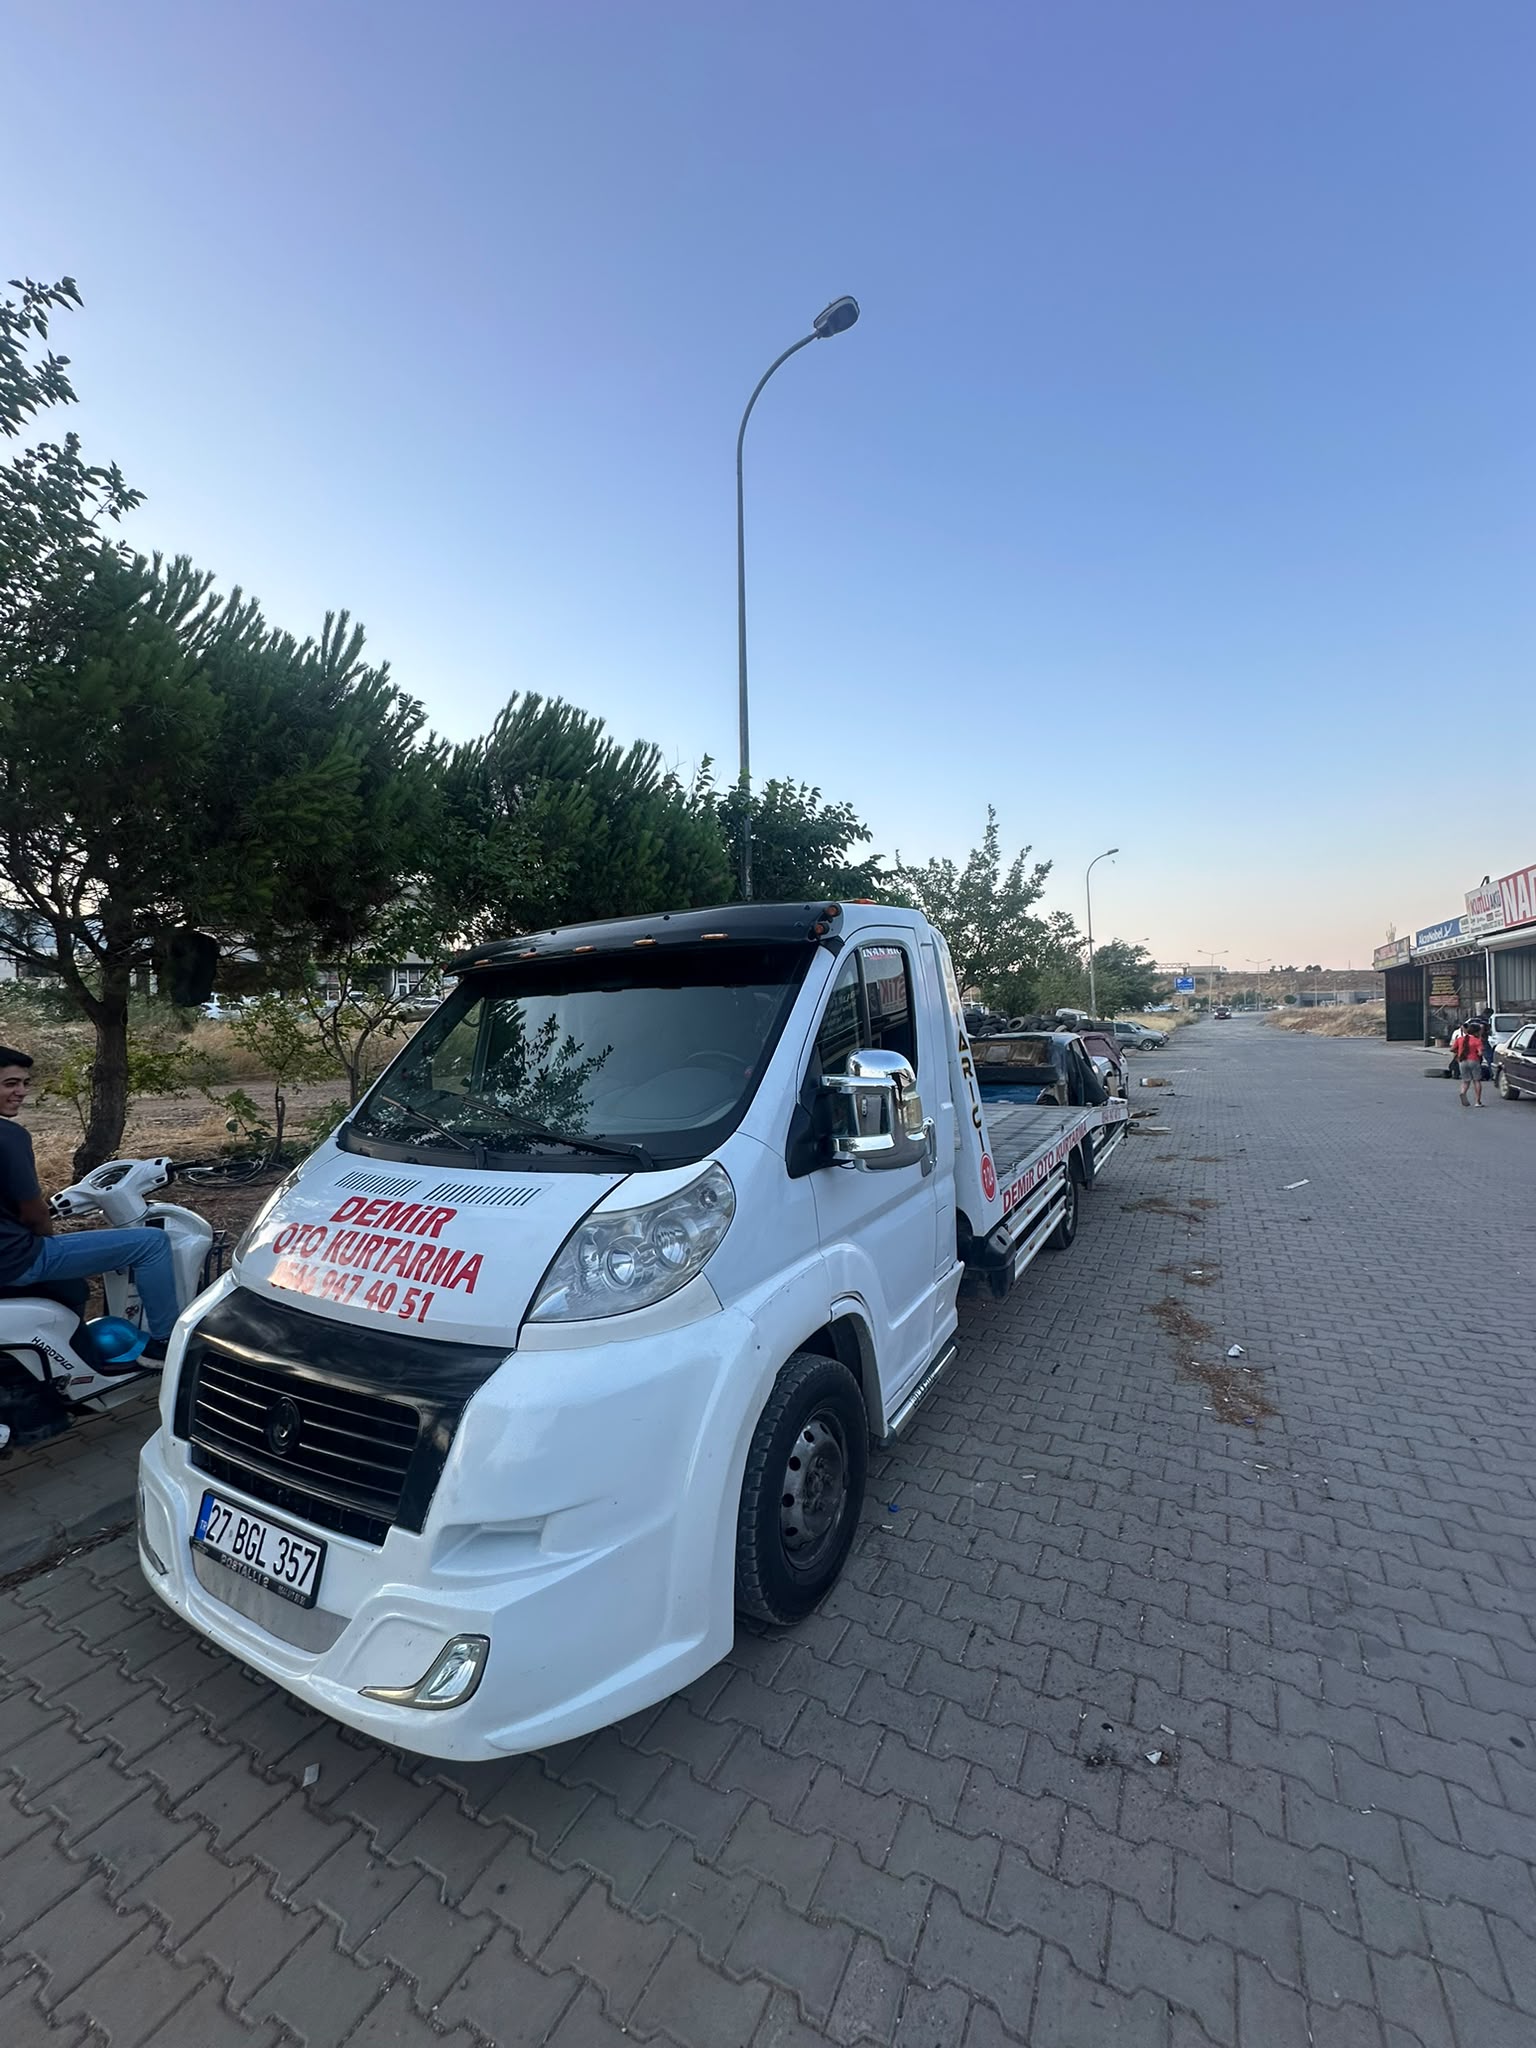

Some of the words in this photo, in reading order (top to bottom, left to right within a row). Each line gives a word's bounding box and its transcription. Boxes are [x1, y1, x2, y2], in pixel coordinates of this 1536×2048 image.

[1037, 1151, 1054, 1180] OTO
[272, 1222, 326, 1258] OTO
[320, 1229, 485, 1294] KURTARMA
[319, 1269, 365, 1304] 947
[364, 1280, 398, 1313] 40
[398, 1287, 435, 1323] 51
[205, 1504, 233, 1544] 27
[232, 1517, 267, 1568] BGL
[273, 1537, 317, 1587] 357
